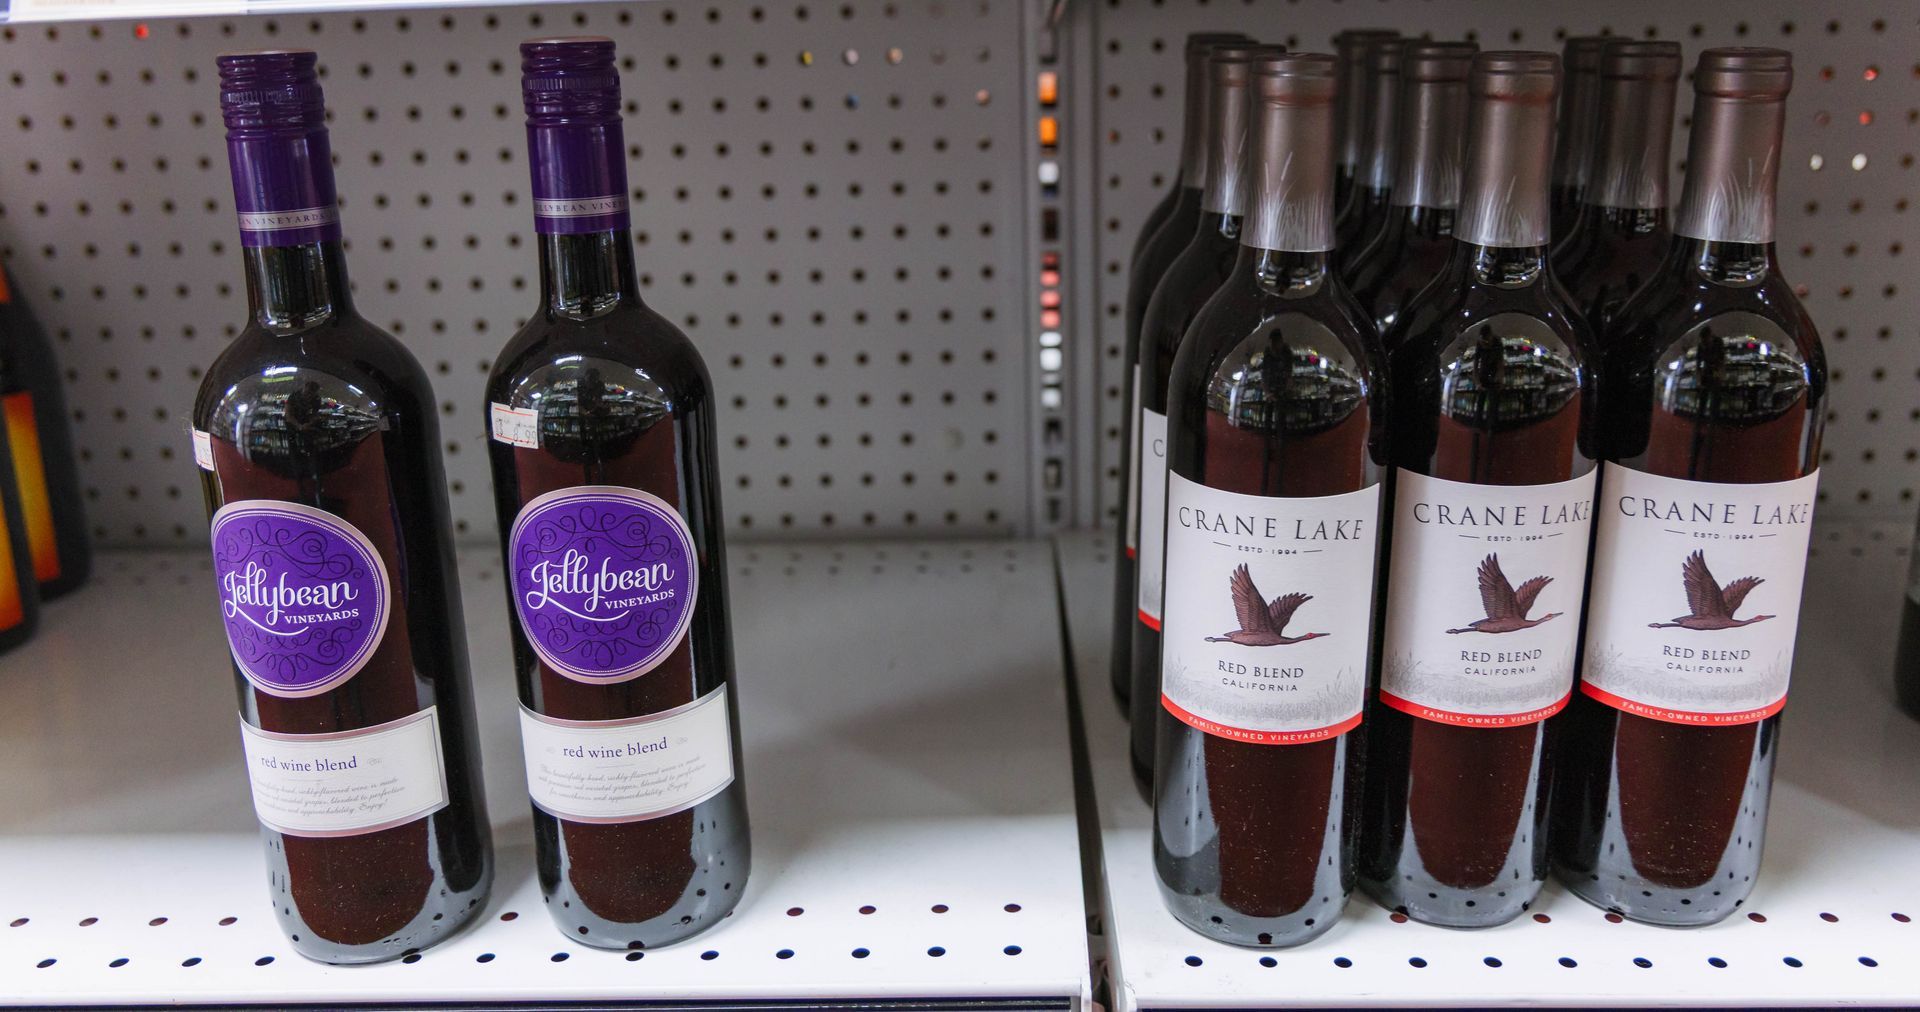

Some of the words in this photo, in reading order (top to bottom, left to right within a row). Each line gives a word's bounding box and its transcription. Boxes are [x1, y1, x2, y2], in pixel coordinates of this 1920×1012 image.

[1413, 503, 1526, 526] CRANE
[1541, 500, 1590, 525] LAKE
[1619, 496, 1737, 524] CRANE
[1752, 503, 1809, 525] LAKE
[1179, 506, 1277, 538] CRANE
[1294, 519, 1363, 540] LAKE
[526, 549, 675, 621] Jellybean
[224, 561, 359, 636] Jellybean
[604, 588, 675, 610] VINEYARDS
[284, 608, 359, 624] VINEYARDS
[1461, 650, 1491, 663] RED
[1497, 649, 1542, 663] BLEND
[1663, 645, 1694, 659] RED
[1702, 649, 1750, 661] BLEND
[1218, 660, 1246, 675] RED
[1254, 666, 1304, 679] BLEND
[1464, 666, 1536, 676] CALIFORNIA
[1666, 662, 1743, 673] CALIFORNIA
[1222, 678, 1298, 691] CALIFORNIA
[1422, 709, 1505, 724] FAMILY-OWNED
[1511, 705, 1557, 723] VINEYARDS
[1621, 701, 1708, 722] FAMILY-OWNED
[1714, 710, 1767, 722] VINEYARDS
[1188, 716, 1264, 740] FAMILY-OWNED
[1271, 729, 1329, 741] VINEYARDS
[563, 745, 584, 758] red
[588, 747, 622, 758] wine
[627, 737, 668, 756] blend
[261, 756, 277, 768] red
[280, 759, 311, 771] wine
[316, 755, 357, 771] blend
